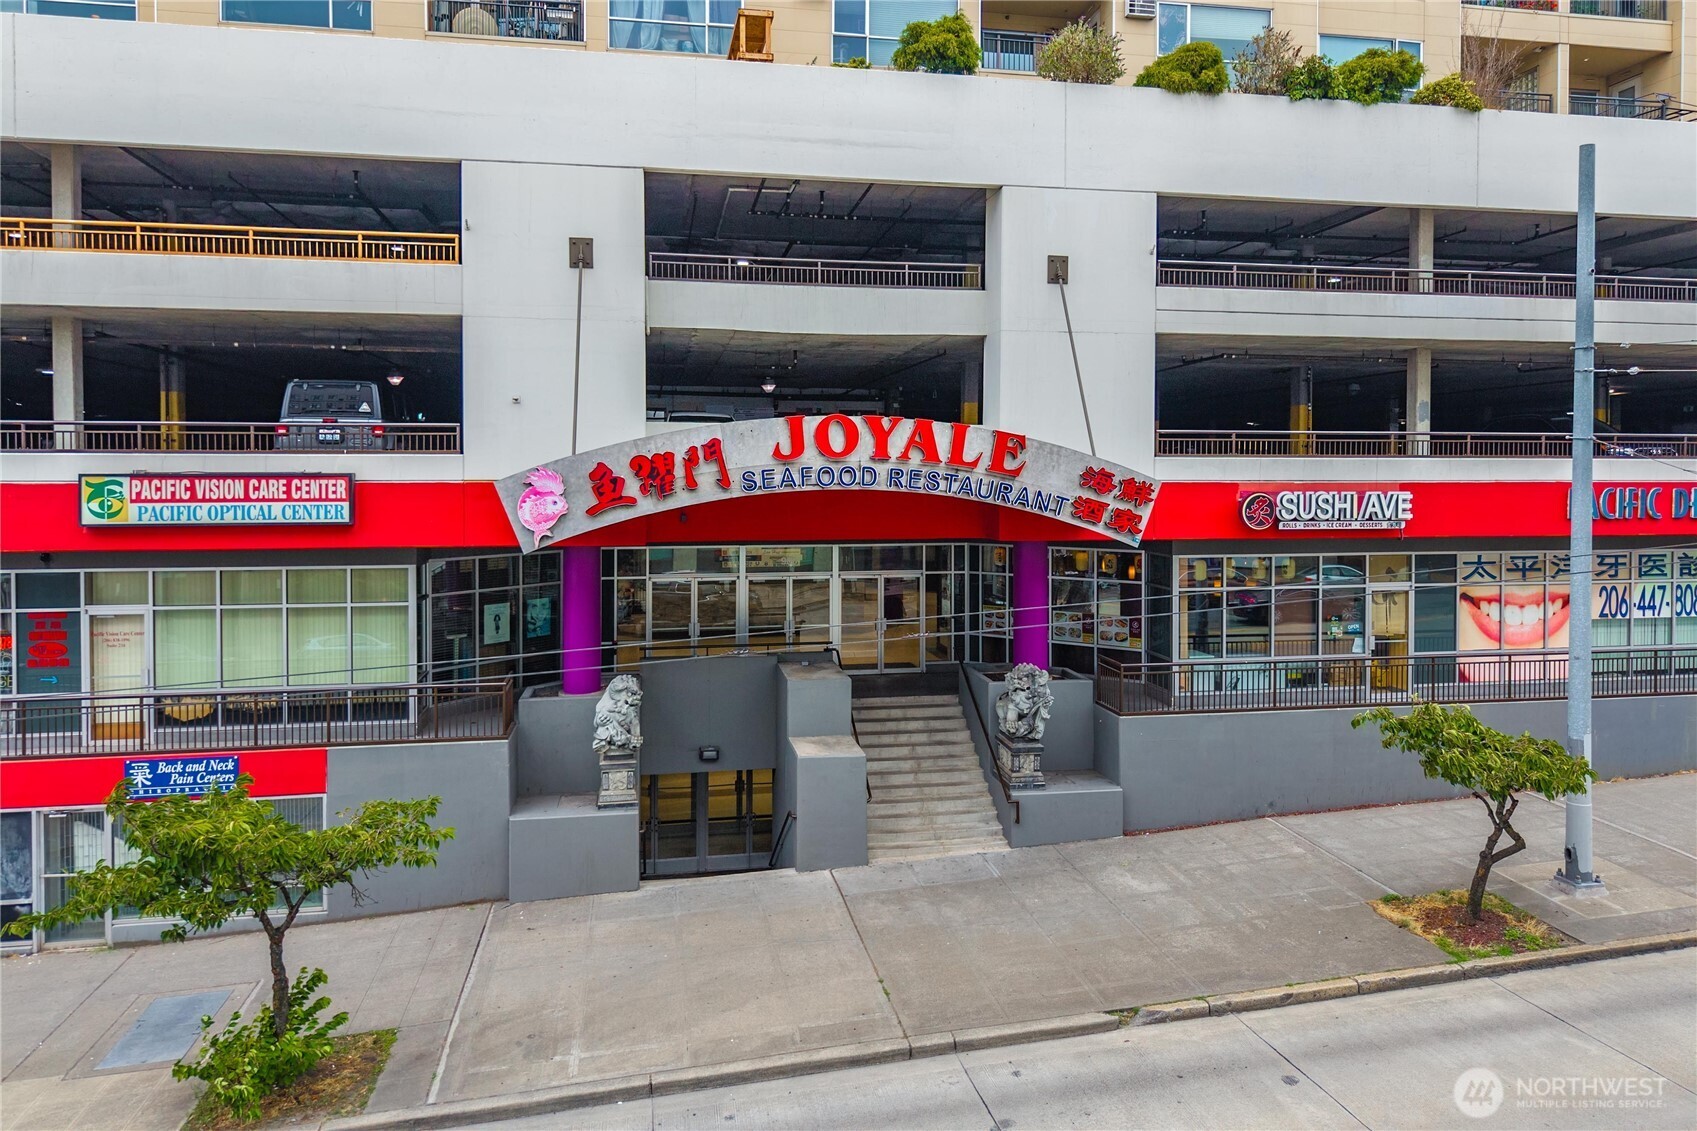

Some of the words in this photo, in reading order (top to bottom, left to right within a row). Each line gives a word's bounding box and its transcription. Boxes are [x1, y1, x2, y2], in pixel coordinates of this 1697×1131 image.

[771, 413, 1026, 478] JOYALE
[131, 479, 191, 500] PACIFIC
[196, 479, 245, 500] VISION
[250, 479, 287, 500] CARE
[291, 478, 346, 499] CENTER
[741, 465, 878, 493] SEAFOOD
[887, 468, 1070, 517] RESTAURANT
[1080, 466, 1155, 507] 海鮮
[137, 505, 203, 522] PACIFIC
[207, 504, 277, 521] OPTICAL
[281, 504, 345, 520] CENTER
[1071, 495, 1143, 535] 酒家
[1276, 491, 1358, 521] SUSHI
[1358, 491, 1413, 521] AVE
[1567, 487, 1662, 519] CIFIC
[1303, 521, 1321, 529] DRINKS
[157, 762, 183, 774] Back
[186, 760, 206, 772] and
[208, 759, 234, 771] Neck
[169, 773, 193, 785] Pain
[196, 772, 234, 784] Centers
